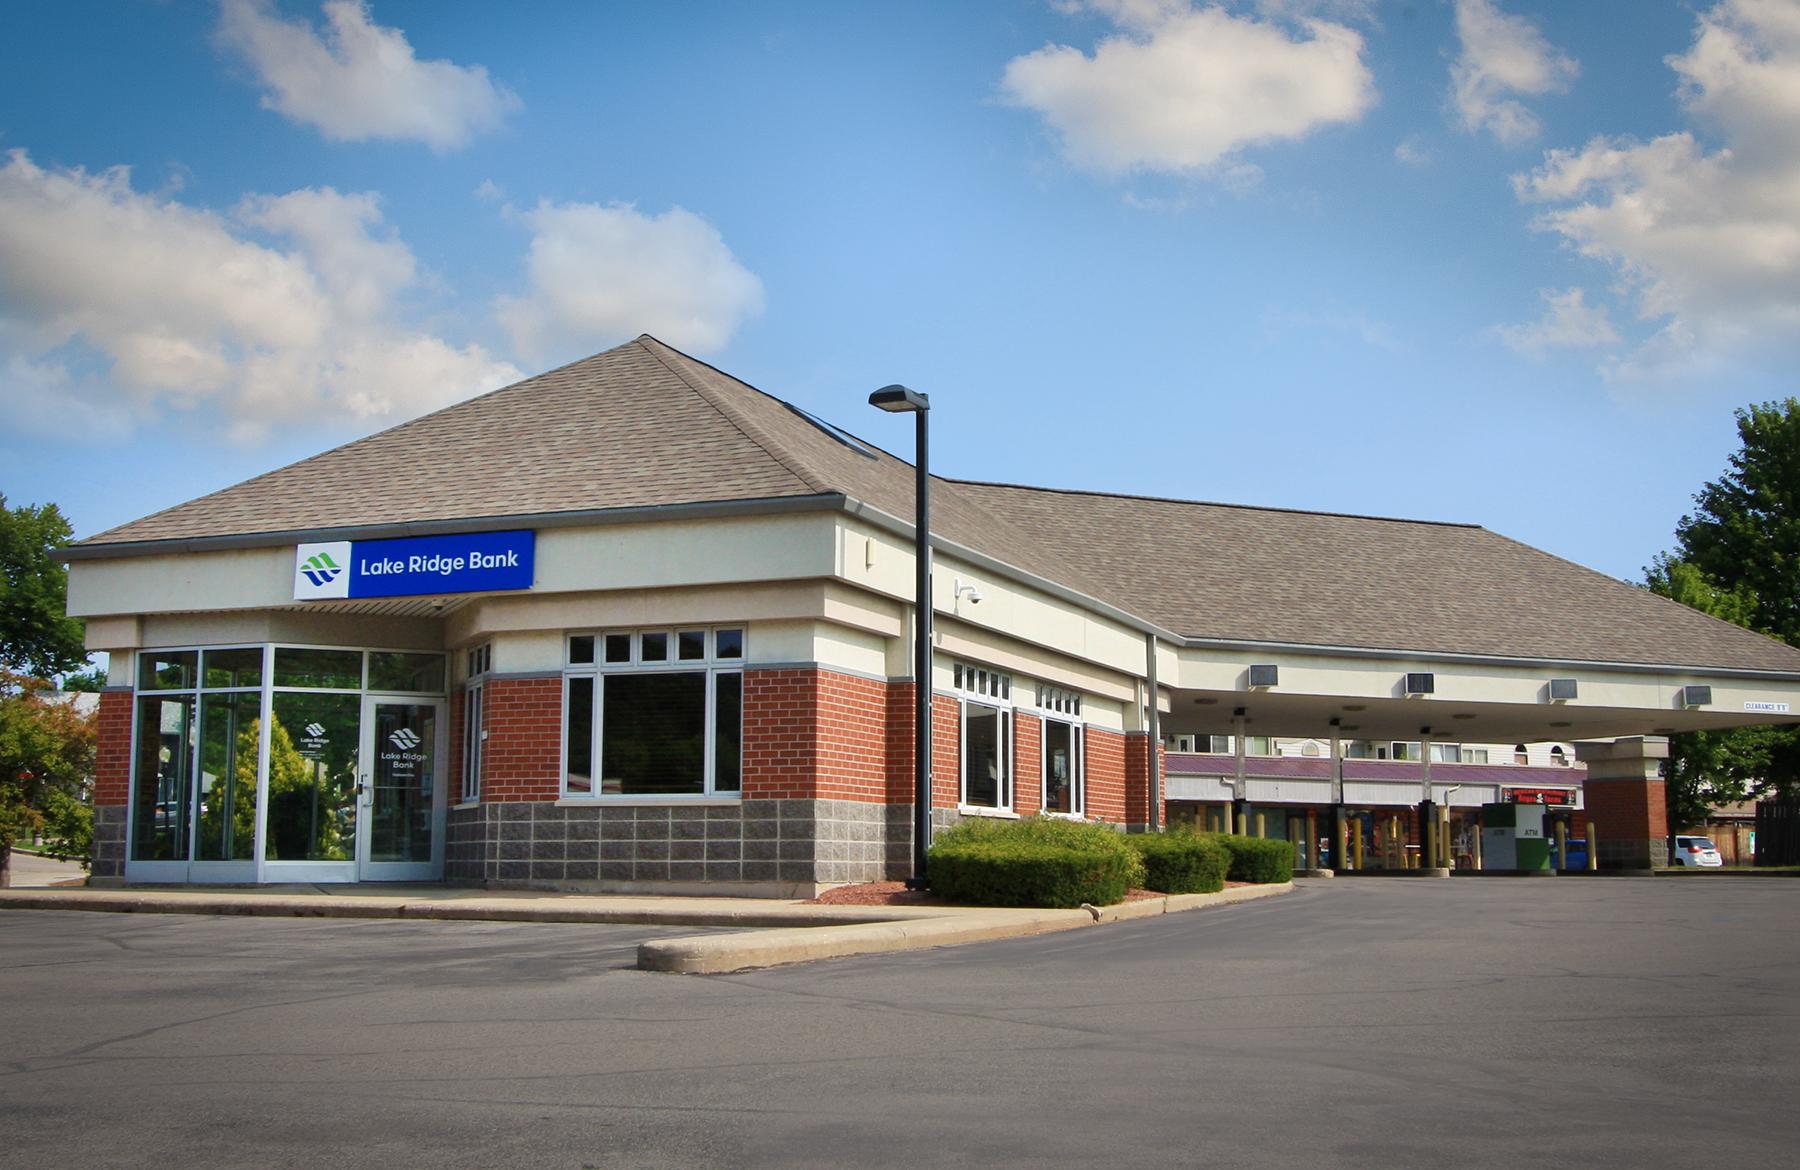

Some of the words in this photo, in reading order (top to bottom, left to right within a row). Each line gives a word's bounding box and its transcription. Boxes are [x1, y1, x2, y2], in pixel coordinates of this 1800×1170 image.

[361, 557, 405, 576] Lake
[409, 554, 465, 576] Ridge
[469, 549, 519, 569] Bank
[381, 752, 401, 760] Lake
[402, 752, 428, 762] Ridge
[392, 761, 415, 769] Bank
[1524, 828, 1538, 836] ATM
